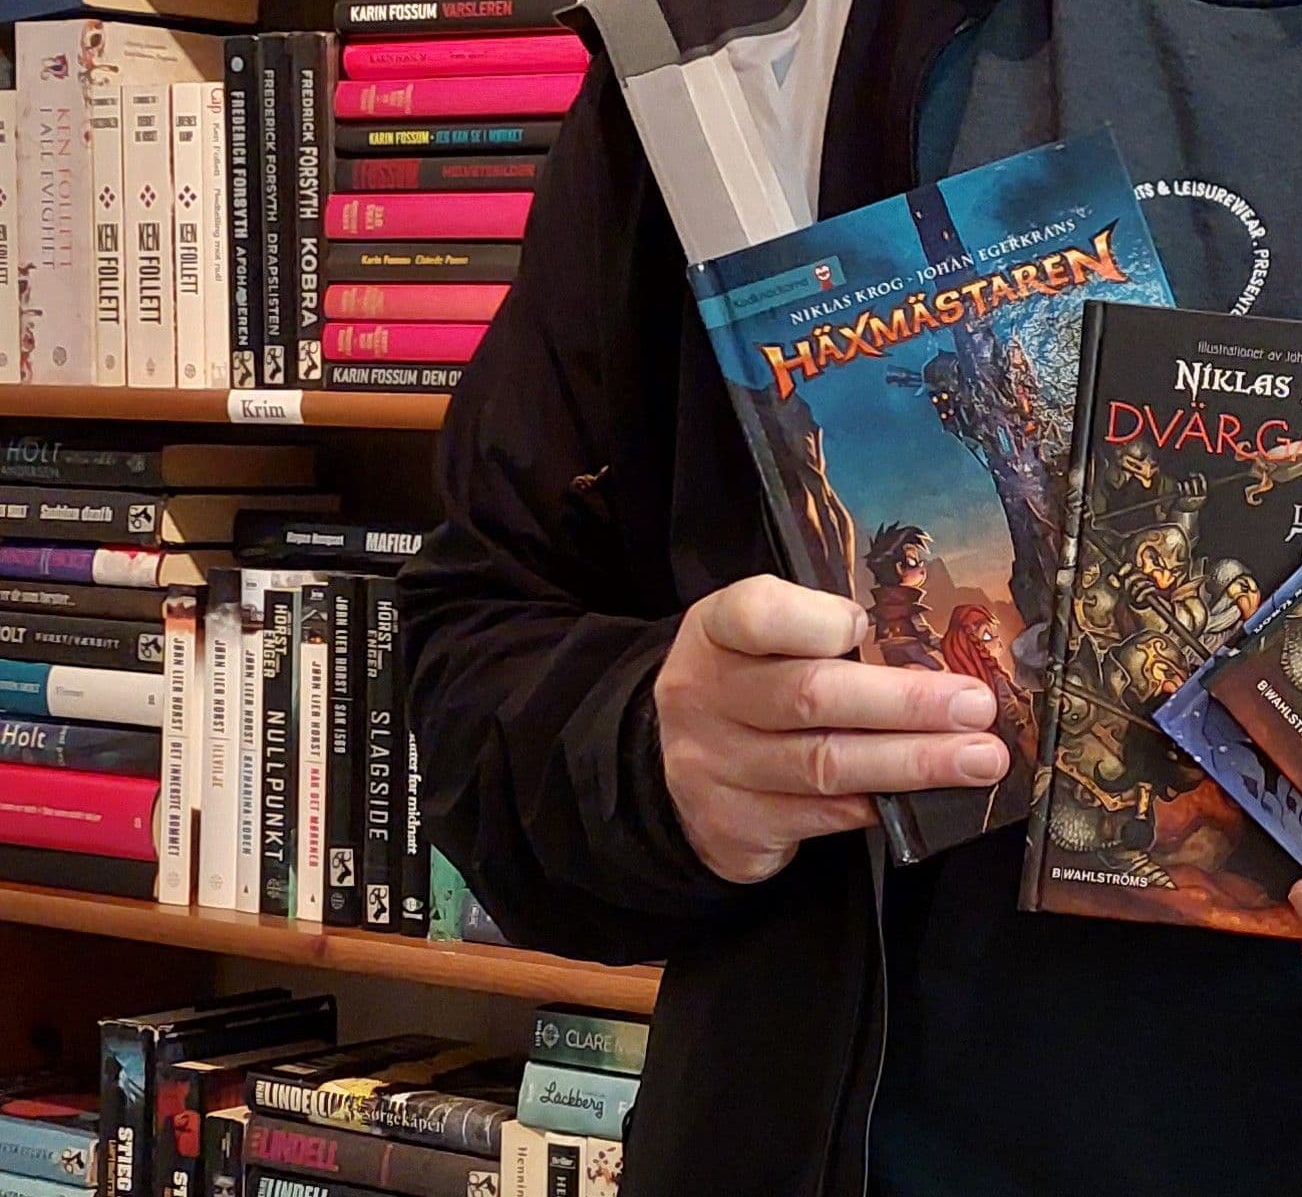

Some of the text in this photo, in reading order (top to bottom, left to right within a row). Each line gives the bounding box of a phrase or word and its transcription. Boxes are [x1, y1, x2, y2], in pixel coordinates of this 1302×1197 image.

[350, 0, 514, 23] KARIN FOSSUM VARSLEREN
[263, 68, 281, 337] FREDERICK FORSYTH DRAPSLISTEN
[298, 68, 319, 329] FREDRICK FORSYTH KOBRA
[1156, 179, 1171, 196] &
[1173, 179, 1266, 240] LEISUREWEAR
[97, 223, 121, 324] KEN FOLLETT
[138, 222, 162, 326] KEN FOLLETT
[788, 294, 852, 326] NIKLAS
[855, 277, 904, 304] KROG
[916, 253, 975, 286] JOHAN
[977, 217, 1076, 263] EGERKRANS
[757, 217, 1132, 402] HÄXMÄSTAREN
[333, 366, 448, 386] KARIN FOSSUM DEN
[241, 399, 288, 420] Krim
[263, 629, 276, 678] ENGER
[274, 604, 288, 655] HORST
[378, 600, 393, 652] HORST
[1, 723, 47, 749] Holt
[263, 710, 287, 863] NULLPUNKT
[368, 710, 390, 842] SLAGSIDE
[116, 1126, 135, 1192] STIEG
